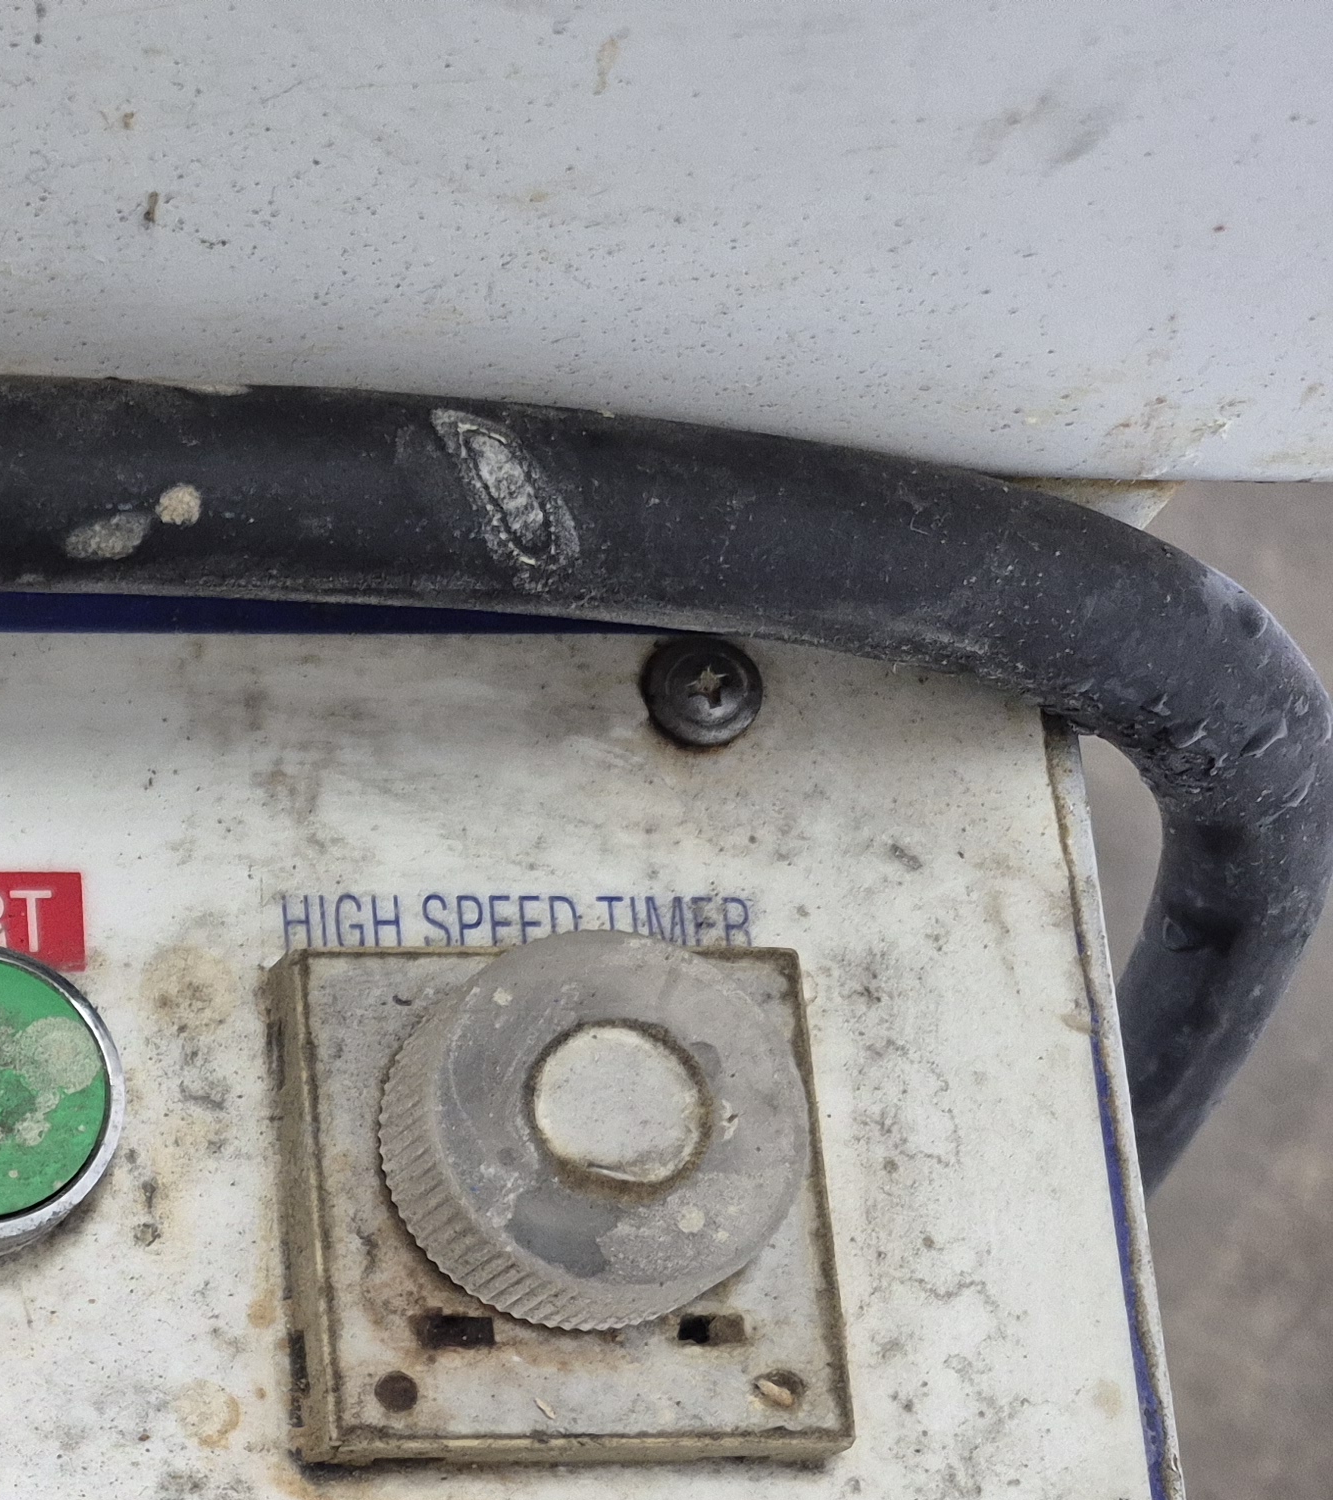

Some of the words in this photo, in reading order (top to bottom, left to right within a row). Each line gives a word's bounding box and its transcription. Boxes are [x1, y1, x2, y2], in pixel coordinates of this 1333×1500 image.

[282, 894, 400, 952] HIGH
[422, 894, 580, 949] SPEED
[596, 895, 752, 948] TIMER
